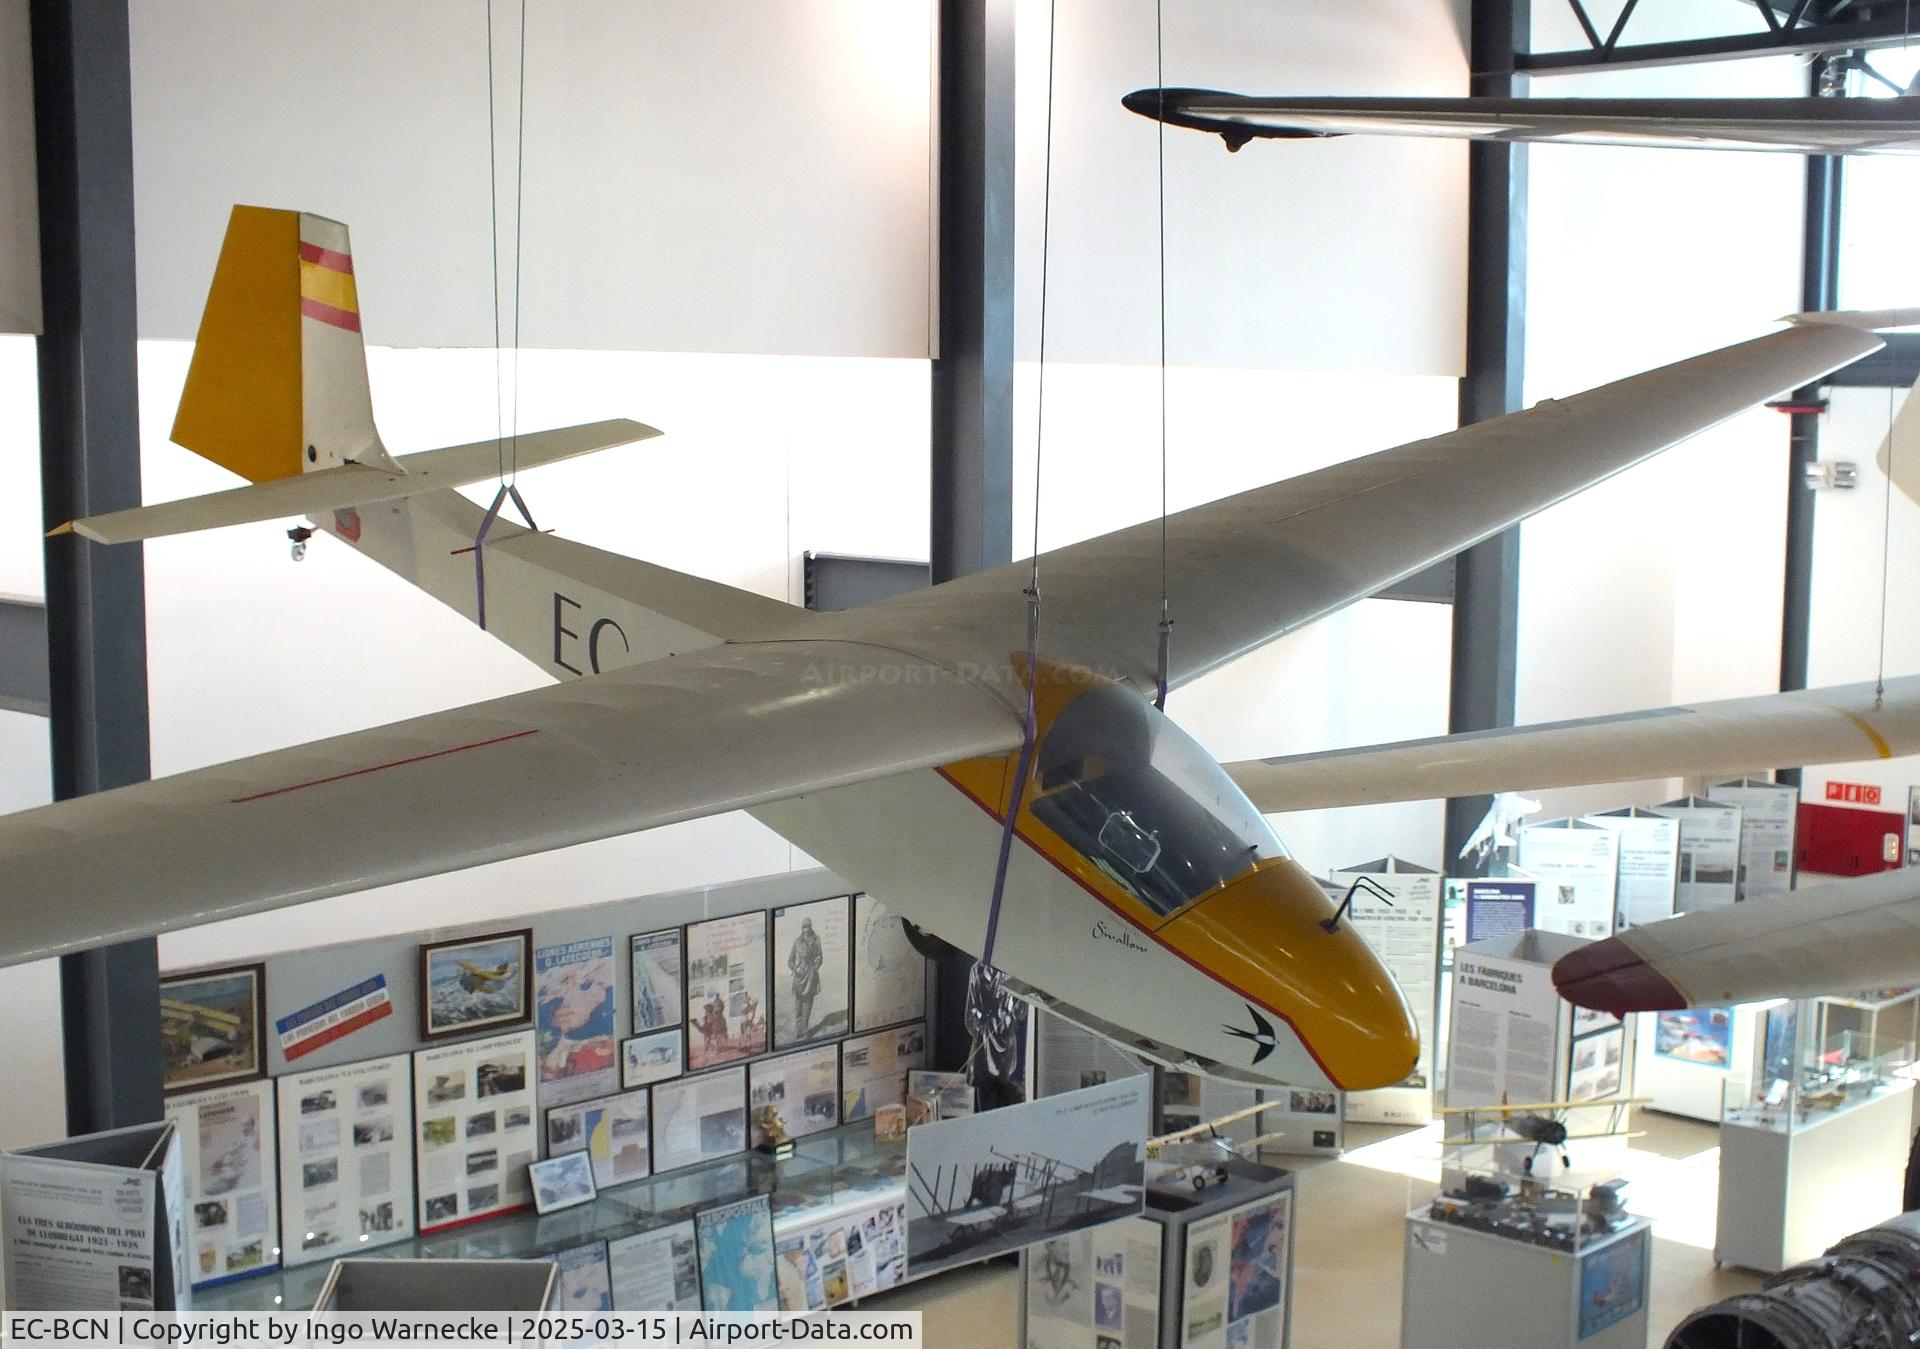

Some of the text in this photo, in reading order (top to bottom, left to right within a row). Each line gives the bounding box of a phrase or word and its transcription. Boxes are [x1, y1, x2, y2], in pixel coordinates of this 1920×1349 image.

[554, 592, 630, 677] EC
[1092, 920, 1148, 953] Swallow
[1459, 975, 1516, 994] A BARCELONA
[1460, 963, 1522, 983] LES FABRIQUES
